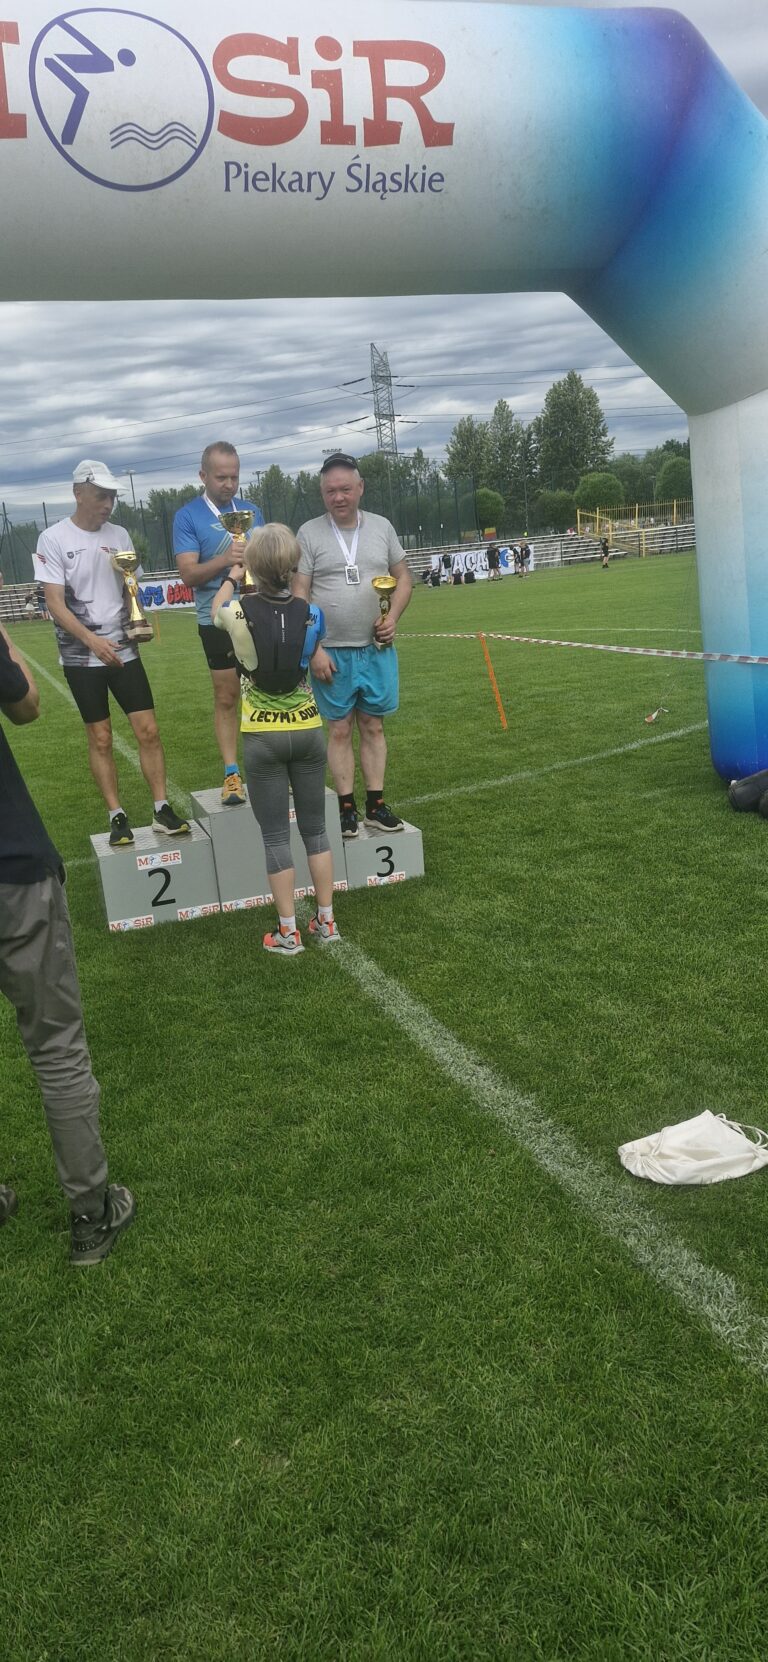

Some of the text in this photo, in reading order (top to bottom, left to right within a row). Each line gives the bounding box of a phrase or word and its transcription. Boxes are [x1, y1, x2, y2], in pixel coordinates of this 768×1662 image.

[223, 154, 445, 200] Piekary Śląskie
[375, 845, 395, 878] 3
[148, 867, 176, 907] 2
